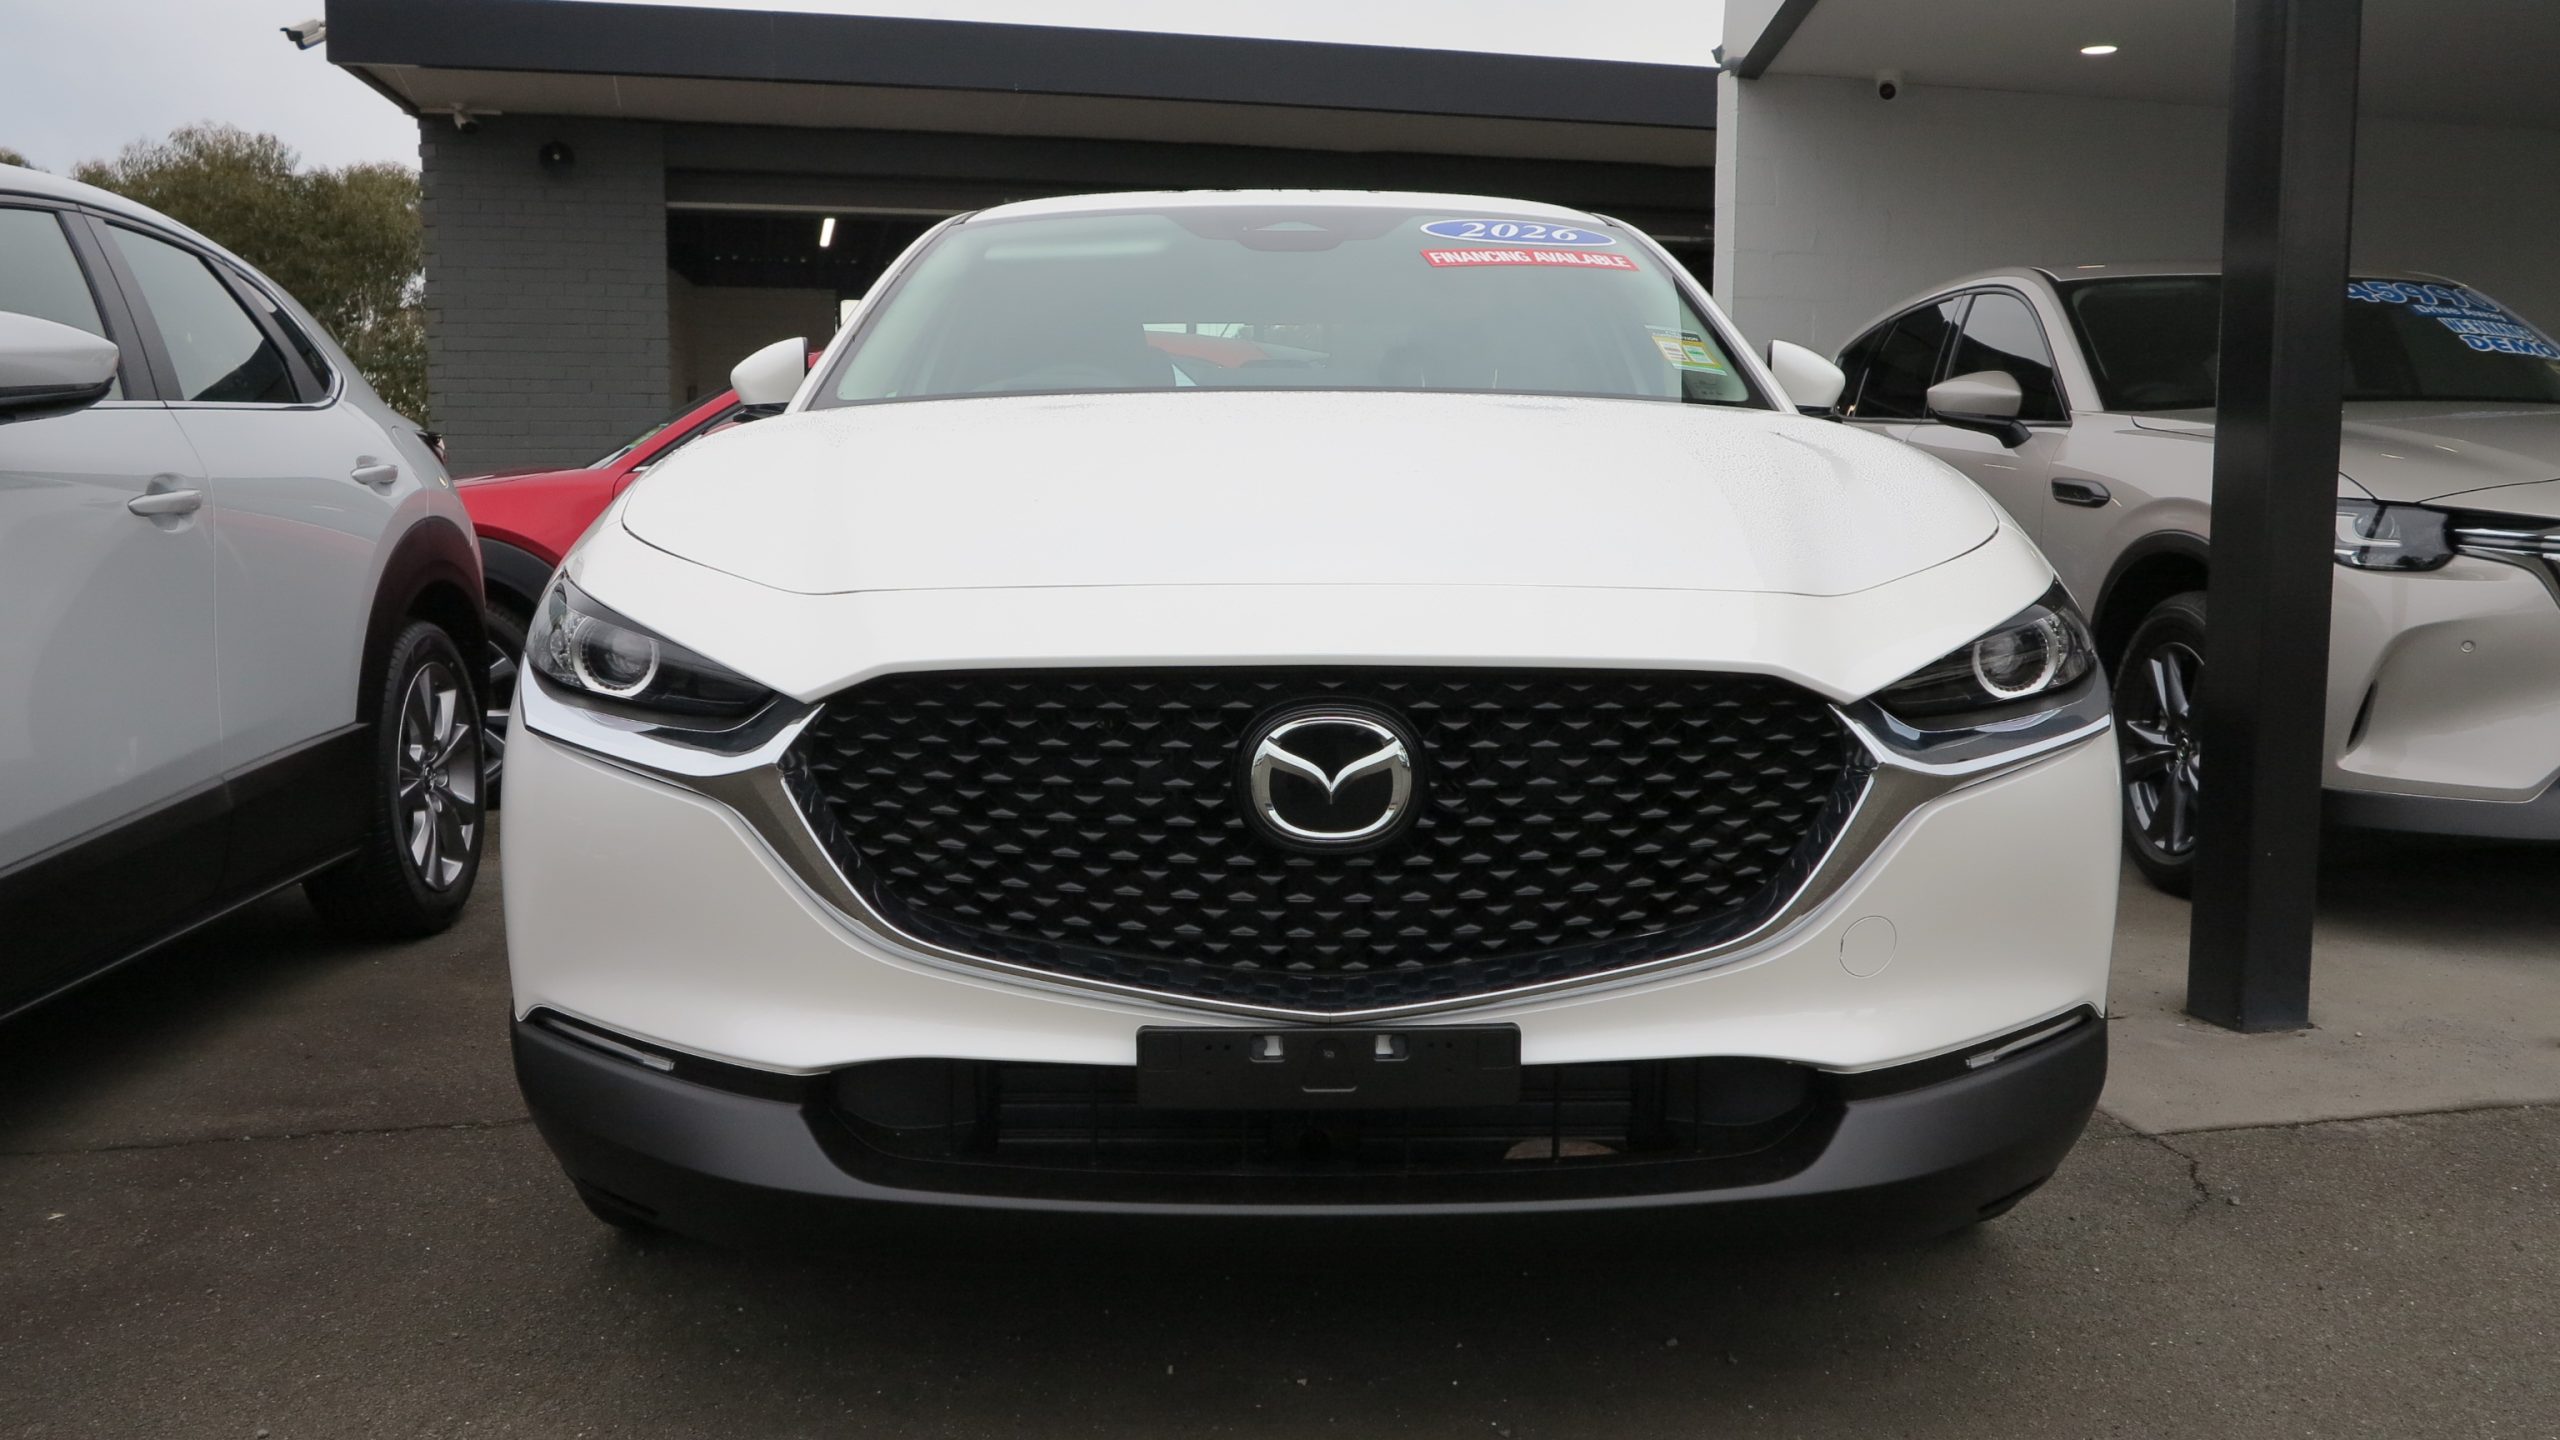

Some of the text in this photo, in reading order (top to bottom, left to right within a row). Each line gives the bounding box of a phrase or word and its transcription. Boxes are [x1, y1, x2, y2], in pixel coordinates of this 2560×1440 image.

[1459, 222, 1579, 241] 2026
[1428, 250, 1632, 267] FINANCING AVAILABLE
[2412, 304, 2460, 317] Drive
[2459, 333, 2560, 360] DEMO
